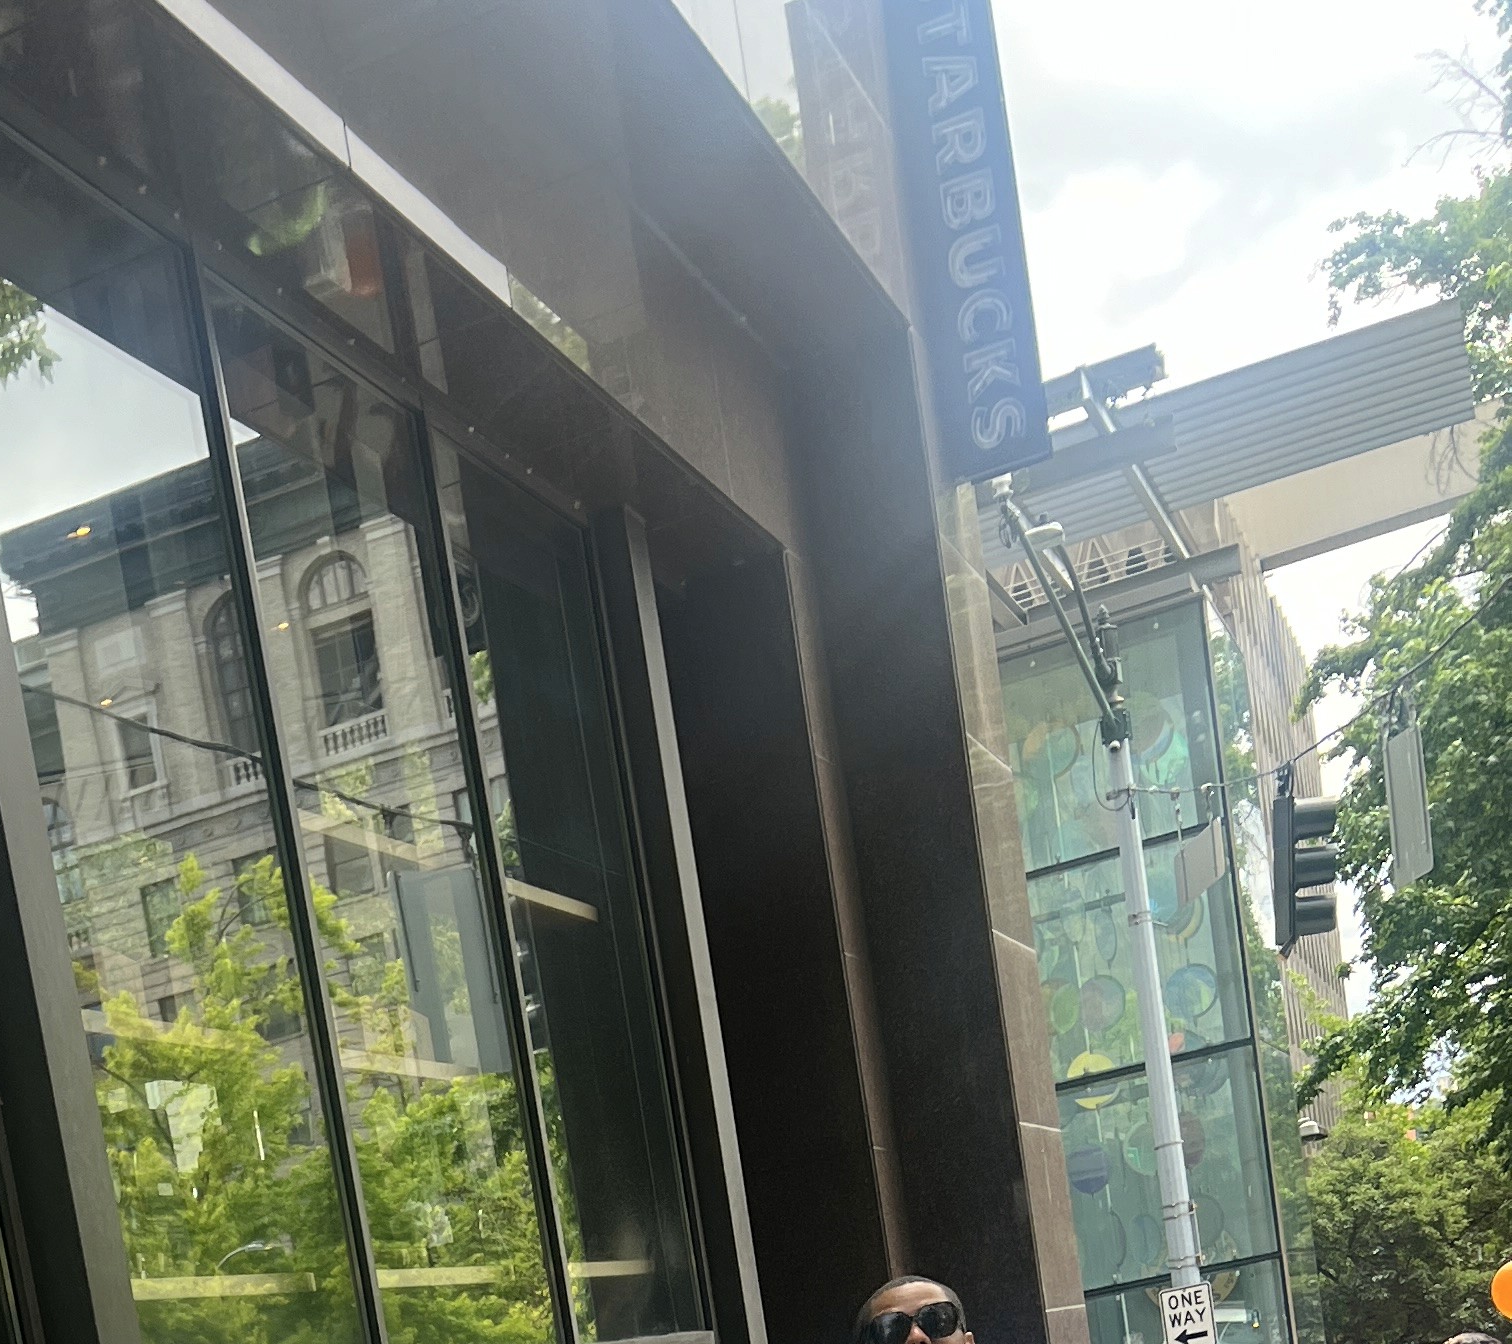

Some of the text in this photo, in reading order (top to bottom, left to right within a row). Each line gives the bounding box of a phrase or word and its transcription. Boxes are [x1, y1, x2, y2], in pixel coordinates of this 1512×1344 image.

[917, 0, 1026, 450] TARBUCKS
[1168, 1289, 1205, 1310] ONE
[1168, 1306, 1207, 1329] WAY
